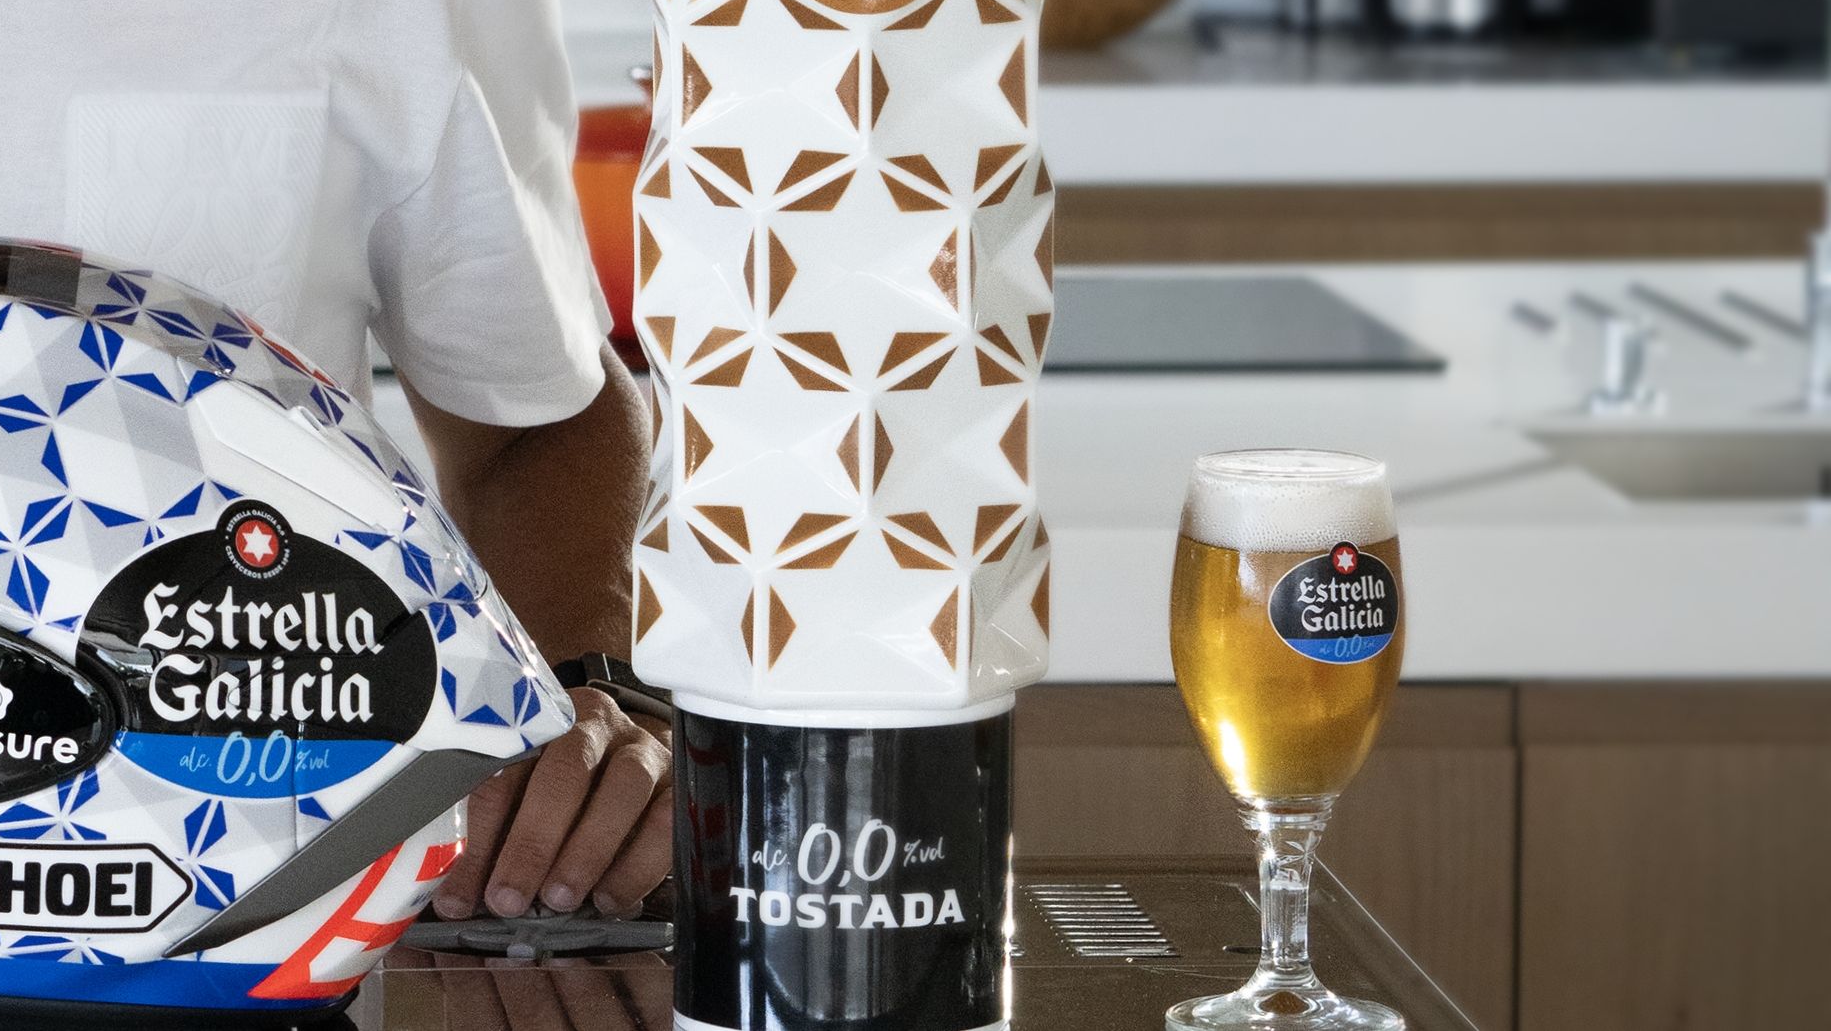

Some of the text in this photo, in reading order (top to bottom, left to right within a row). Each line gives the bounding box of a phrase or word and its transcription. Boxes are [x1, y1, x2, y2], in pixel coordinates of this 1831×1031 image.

[226, 510, 252, 532] ESTRELLA
[251, 509, 277, 526] GALICIA
[225, 545, 262, 579] CERVECEROS
[1296, 575, 1386, 604] Estrella
[138, 582, 385, 655] Estrella
[1301, 603, 1384, 632] Galicia
[1334, 633, 1362, 658] 0,0
[148, 653, 374, 723] Galicia
[216, 729, 292, 786] 0,0
[797, 818, 897, 888] 0,0
[728, 886, 966, 930] TOSTADA
